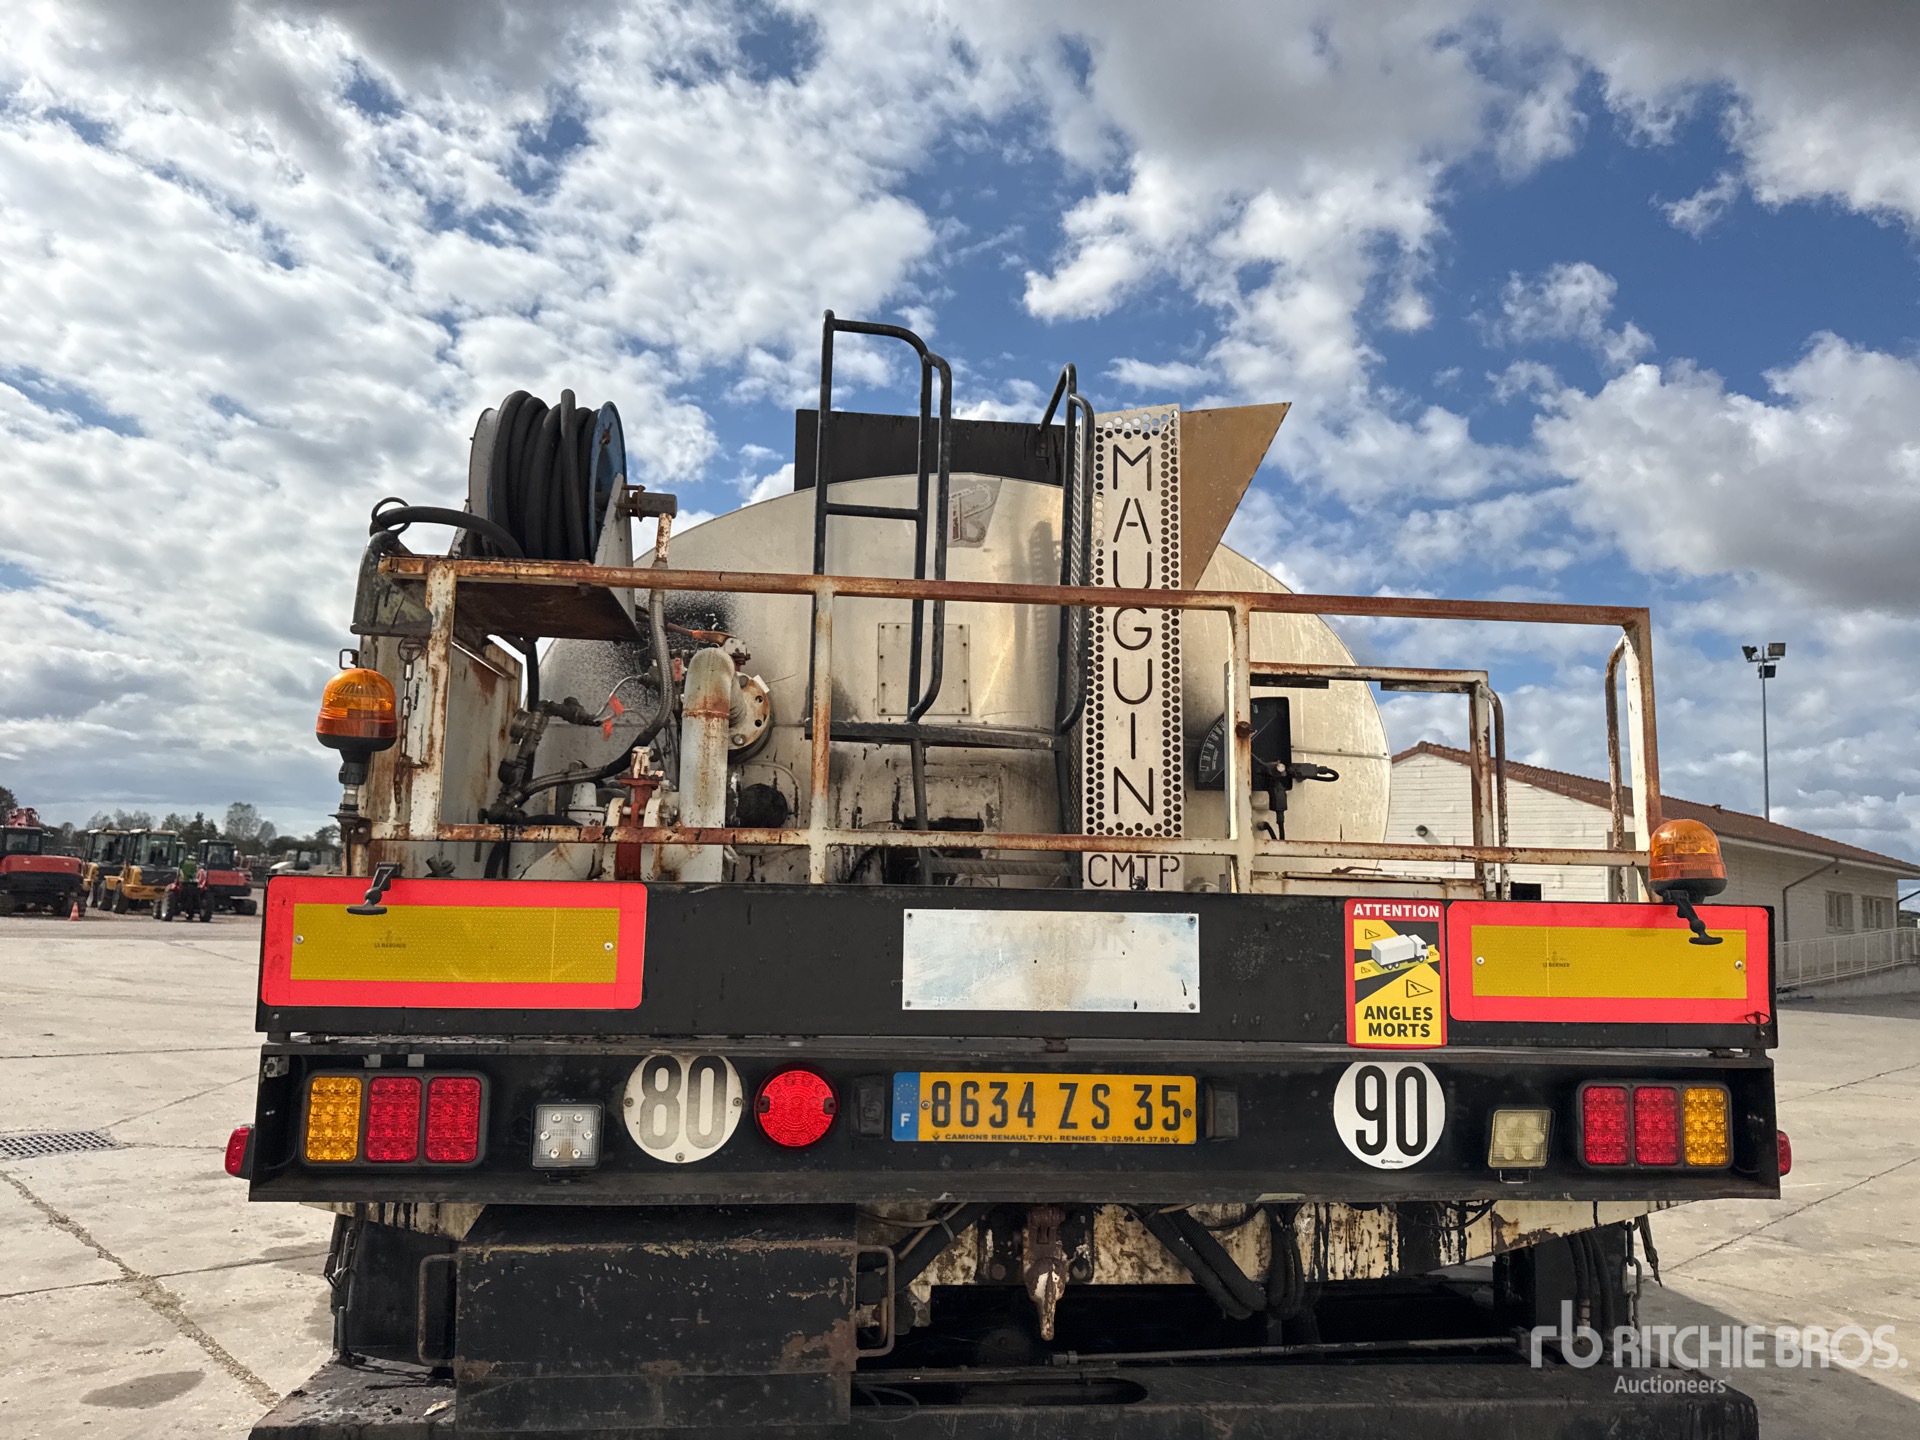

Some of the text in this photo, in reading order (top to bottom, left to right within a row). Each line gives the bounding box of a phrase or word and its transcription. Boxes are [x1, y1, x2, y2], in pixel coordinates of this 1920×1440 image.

[1113, 444, 1153, 816] MAUGUIN
[1088, 854, 1180, 888] CMTP
[1353, 903, 1440, 918] ATTENTION
[1364, 1006, 1433, 1021] ANGLES
[1368, 1023, 1431, 1038] MORTS
[639, 1055, 728, 1150] 80
[931, 1081, 1181, 1132] 8634 ZS 35
[1355, 1064, 1428, 1157] 90
[900, 1113, 911, 1127] F
[944, 1133, 989, 1141] CAMIONS
